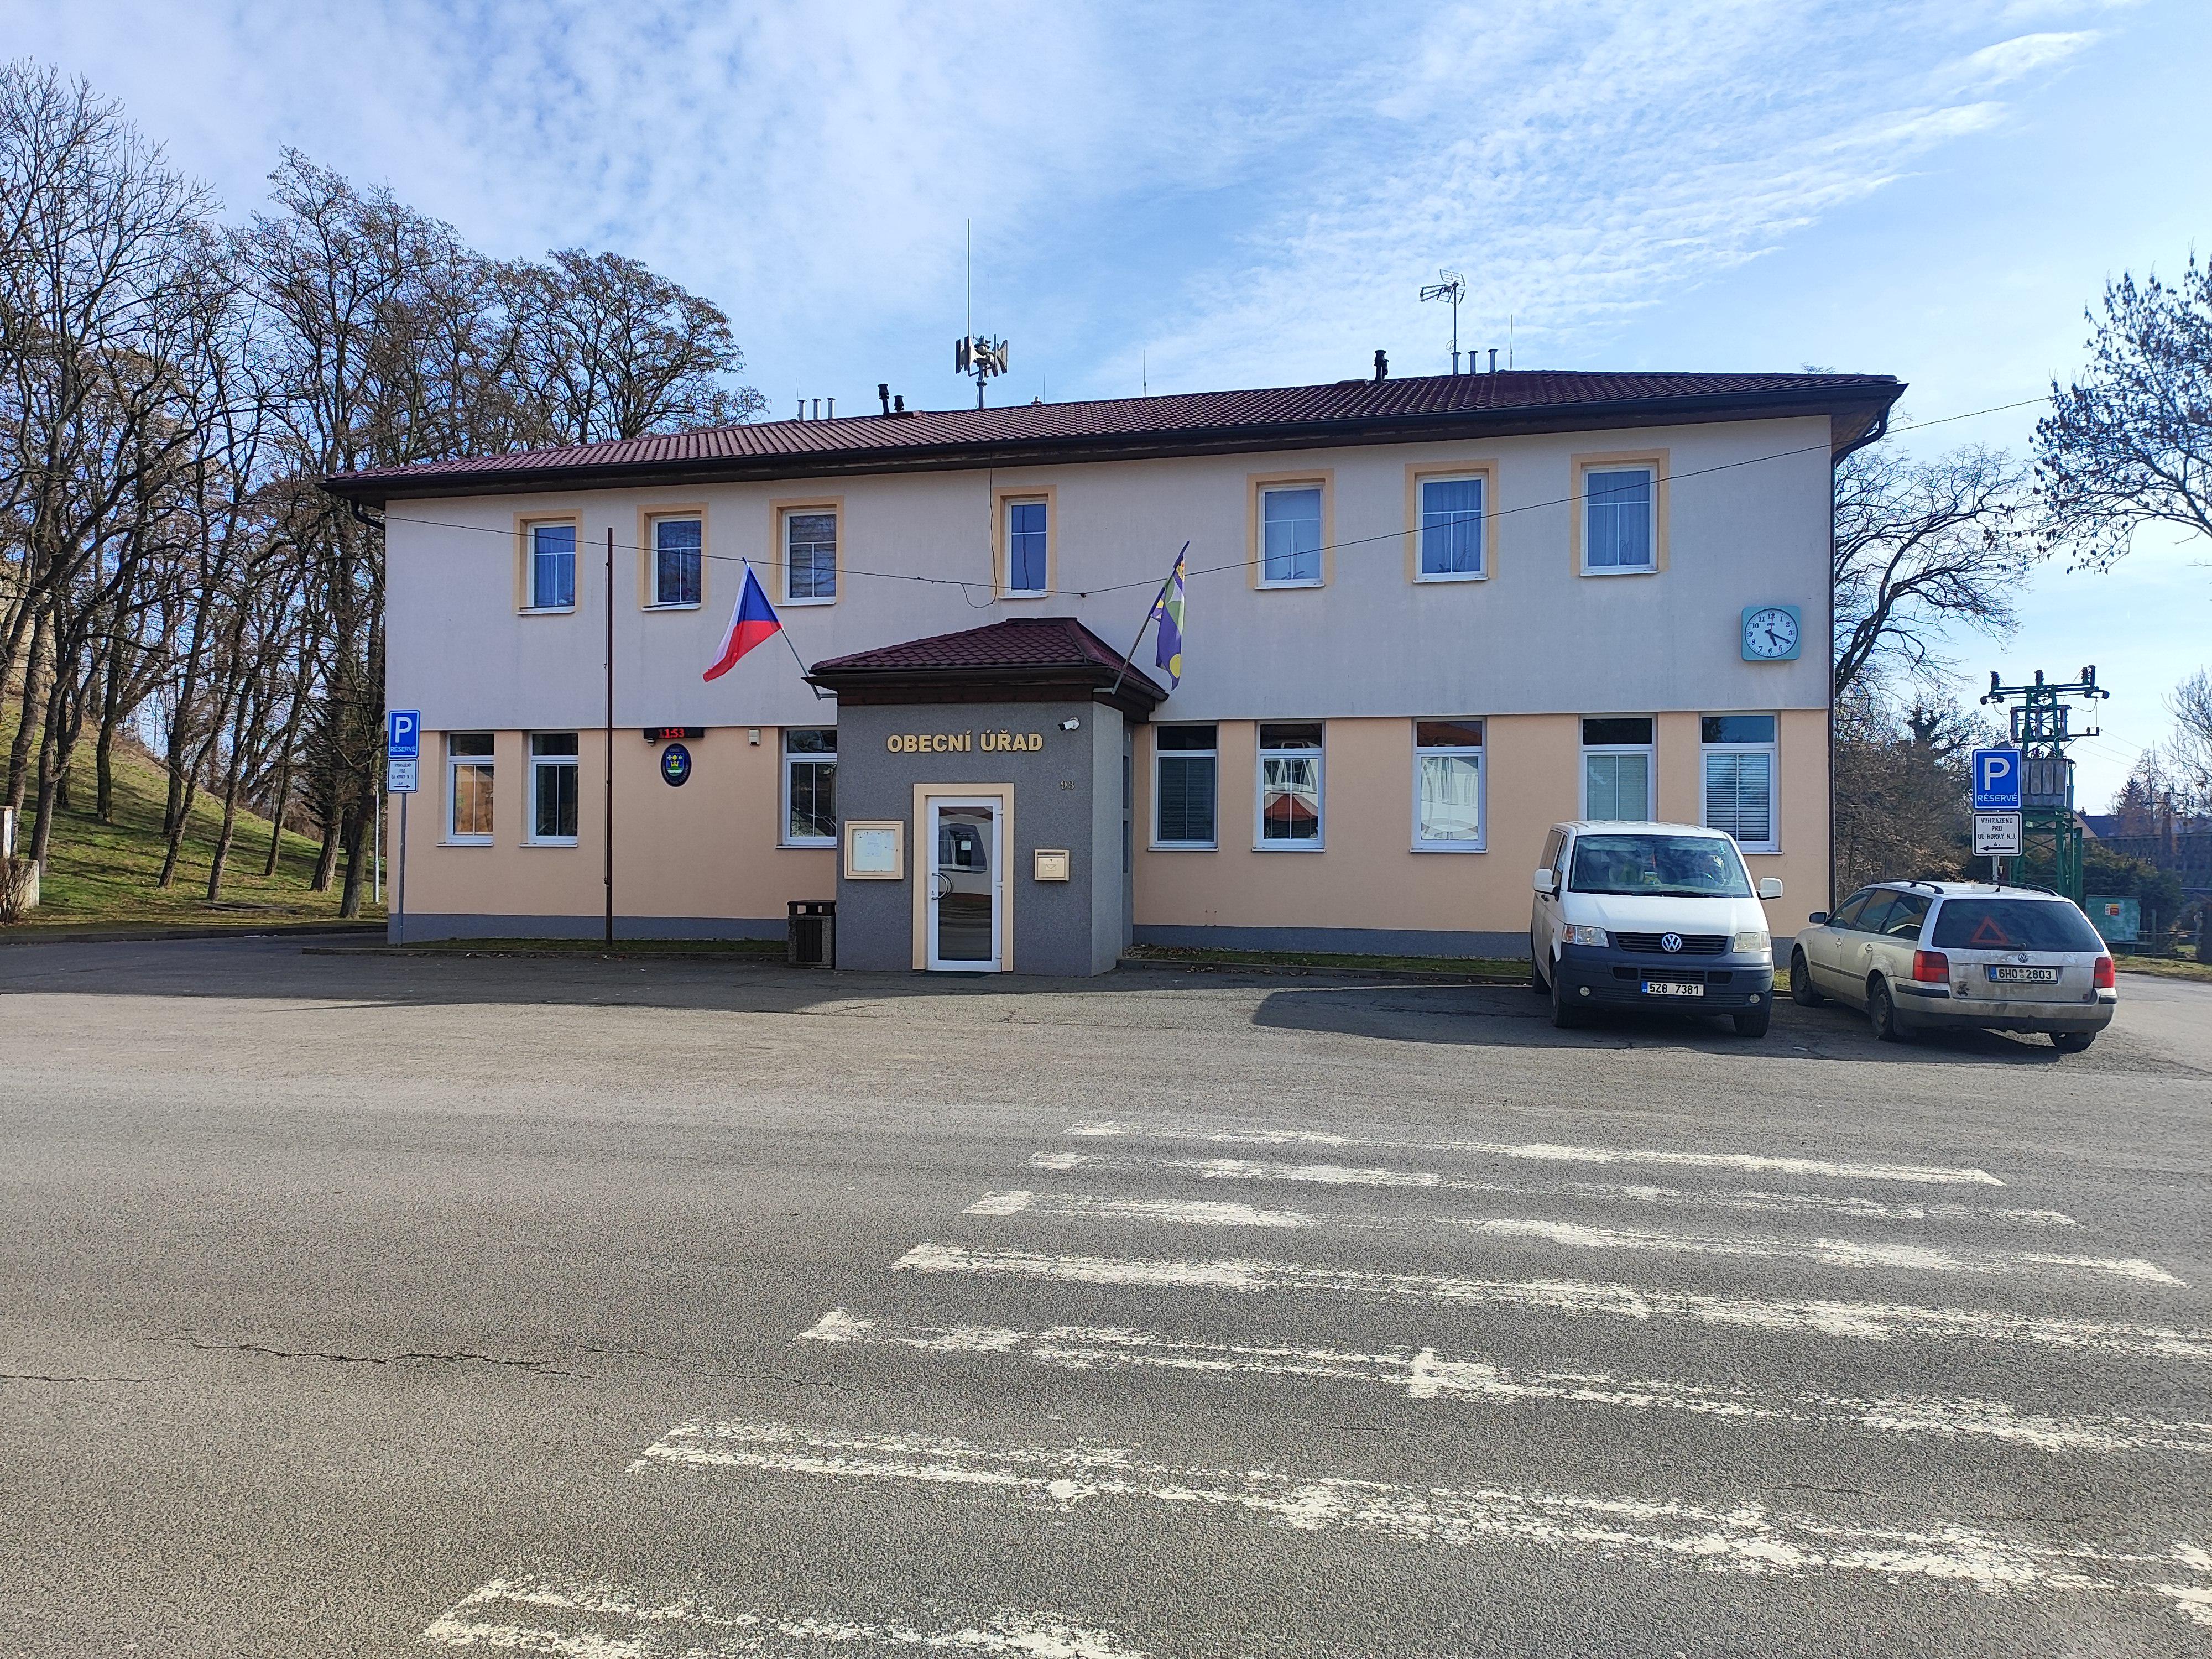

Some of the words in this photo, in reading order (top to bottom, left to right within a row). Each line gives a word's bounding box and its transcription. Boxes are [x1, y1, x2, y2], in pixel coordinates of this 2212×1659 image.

[395, 717, 412, 743] P
[887, 729, 971, 752] OBECNÍ
[980, 729, 1043, 752] ÚŘAD
[1984, 758, 2010, 790] P
[1061, 780, 1075, 790] 93
[1978, 792, 2017, 802] RÉSERVÉ
[2026, 969, 2051, 979] 2803
[1676, 985, 1698, 994] 7381
